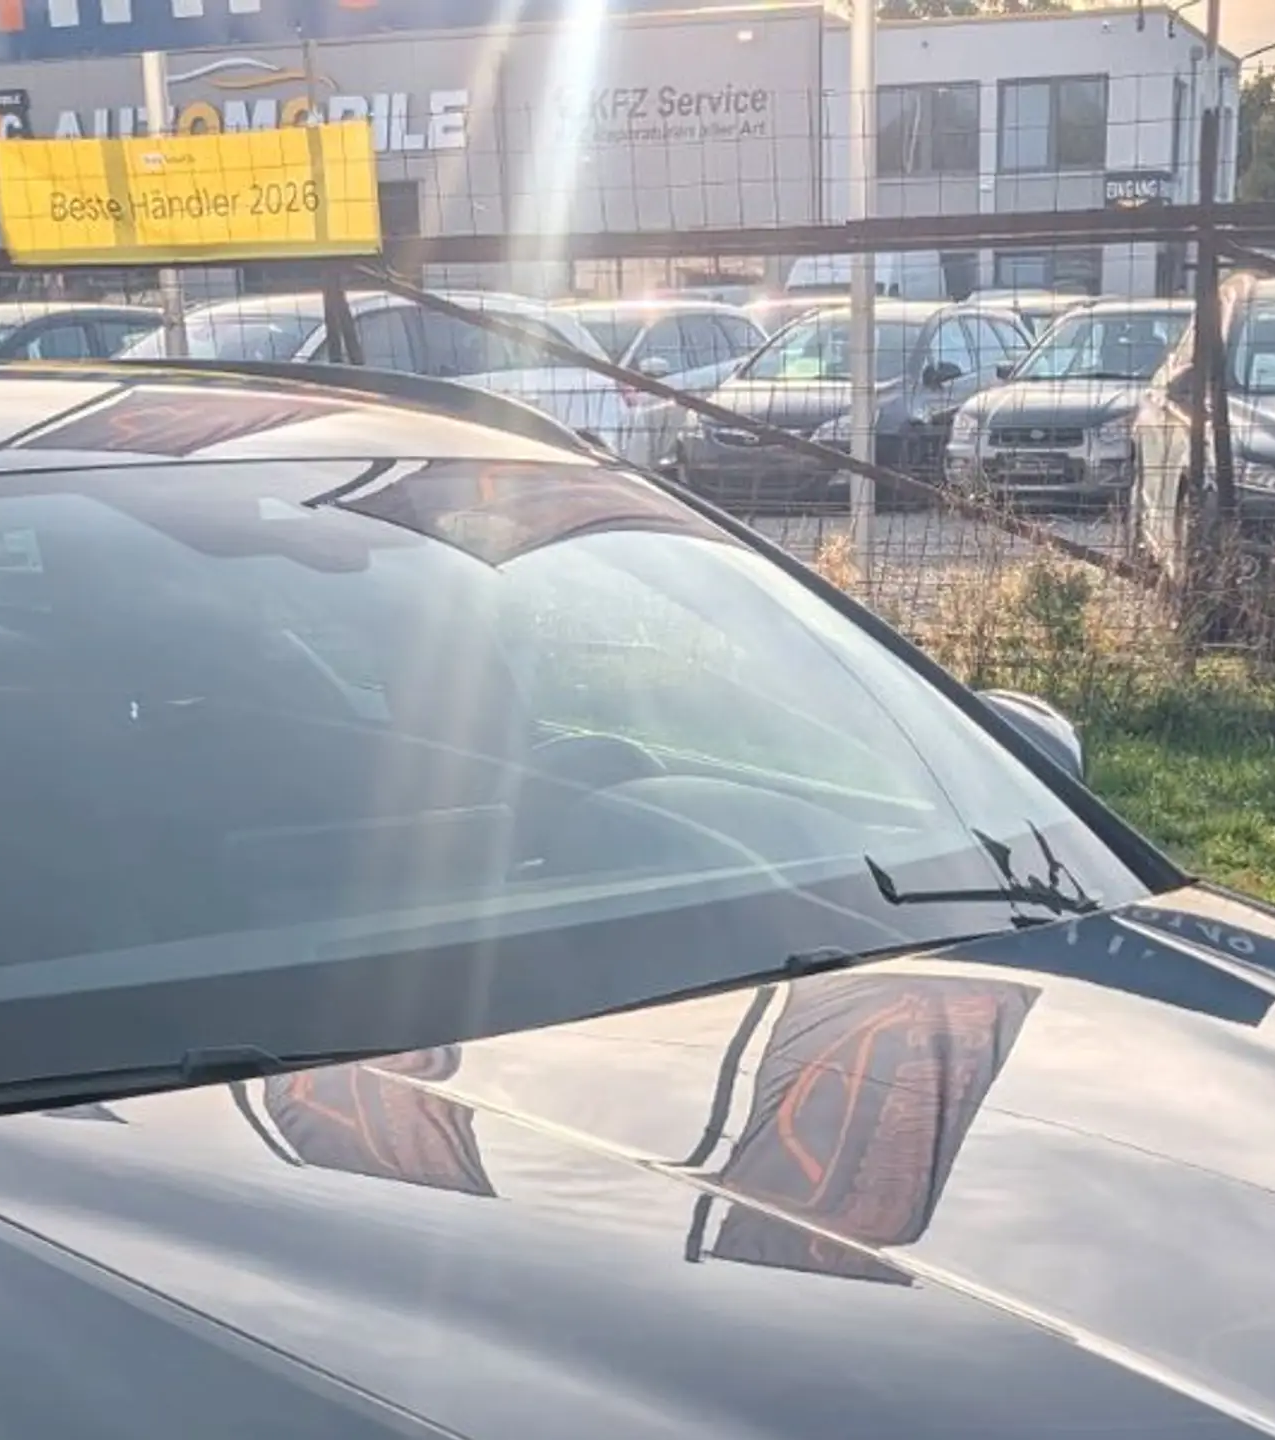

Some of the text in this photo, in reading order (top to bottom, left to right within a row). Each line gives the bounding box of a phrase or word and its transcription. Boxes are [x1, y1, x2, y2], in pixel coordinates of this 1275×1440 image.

[55, 89, 469, 151] AUOMOBILE
[590, 84, 768, 120] KFZ Service
[740, 119, 766, 135] Art
[50, 180, 319, 221] Beste Händler 2026
